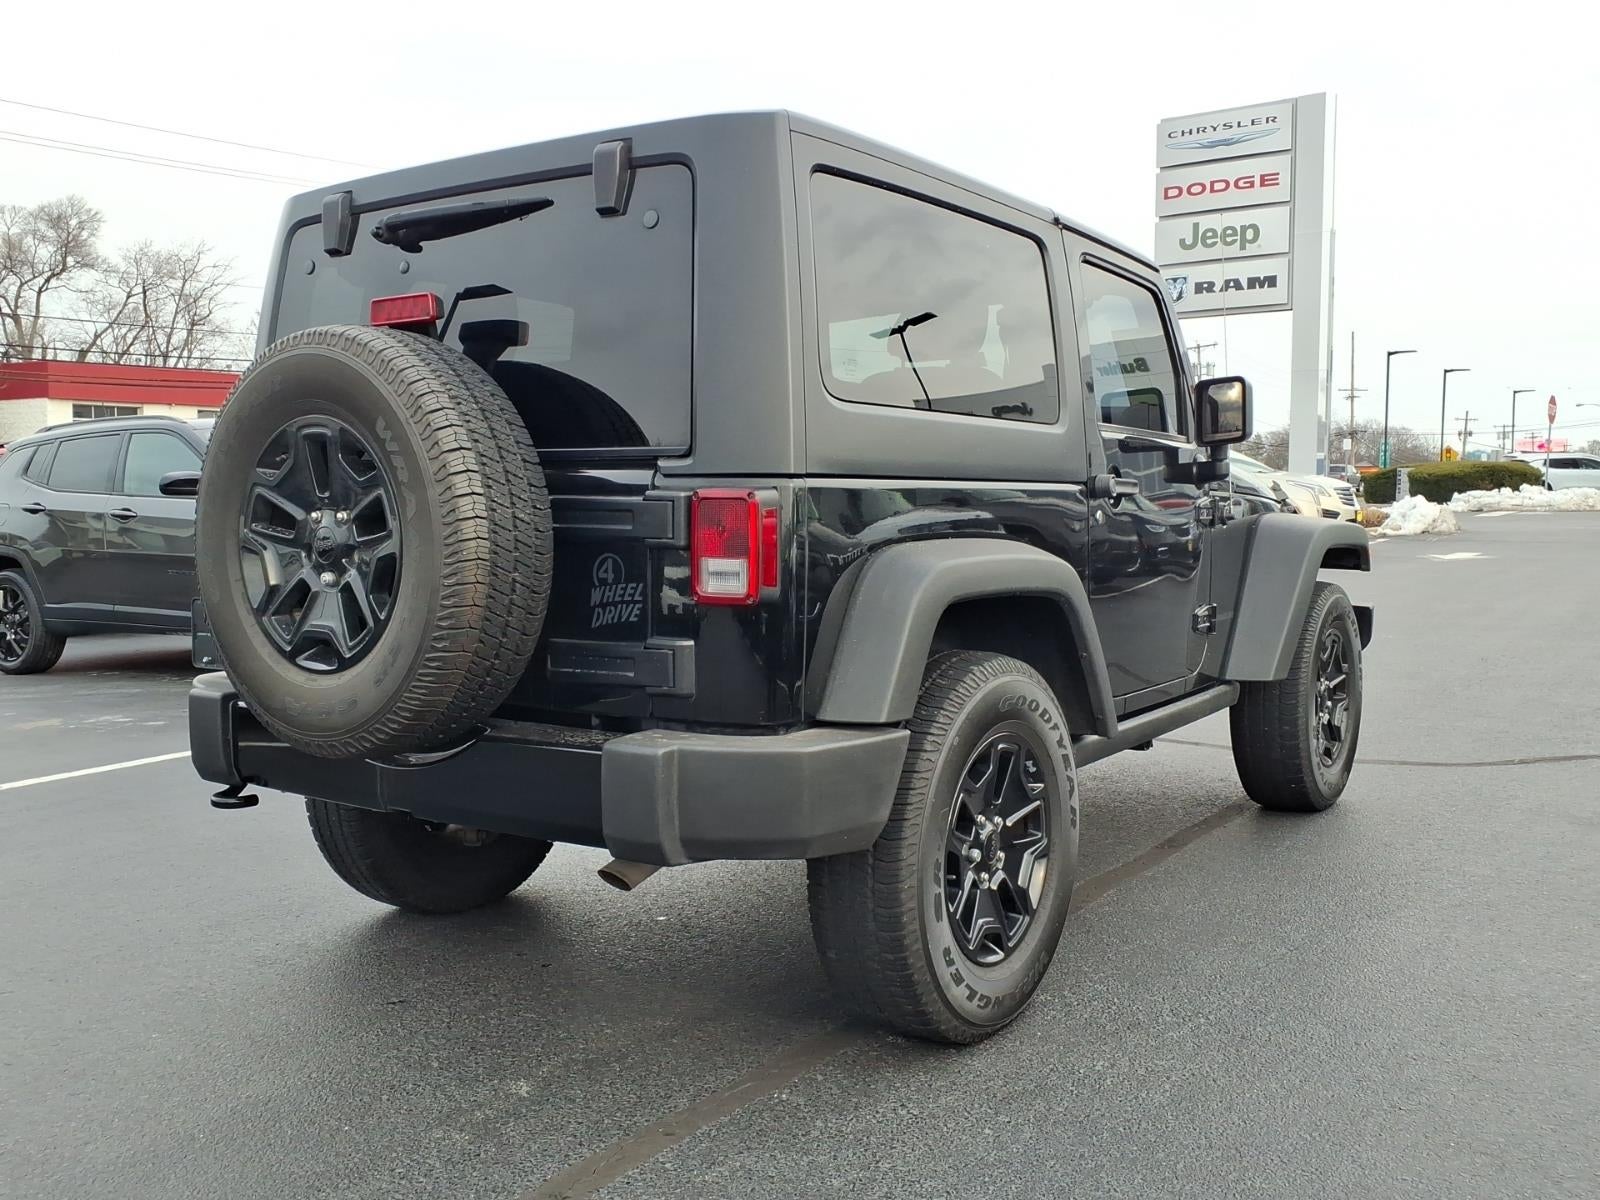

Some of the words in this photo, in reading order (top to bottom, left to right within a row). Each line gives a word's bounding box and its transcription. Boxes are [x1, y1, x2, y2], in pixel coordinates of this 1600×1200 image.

[1167, 115, 1279, 139] CHRYSLER
[1163, 172, 1281, 201] DODGE
[1178, 222, 1261, 251] Jeep
[1194, 274, 1278, 295] RAM
[590, 583, 644, 607] WHEEL
[591, 604, 643, 628] DRIVE
[998, 694, 1078, 830] GOODYEAR
